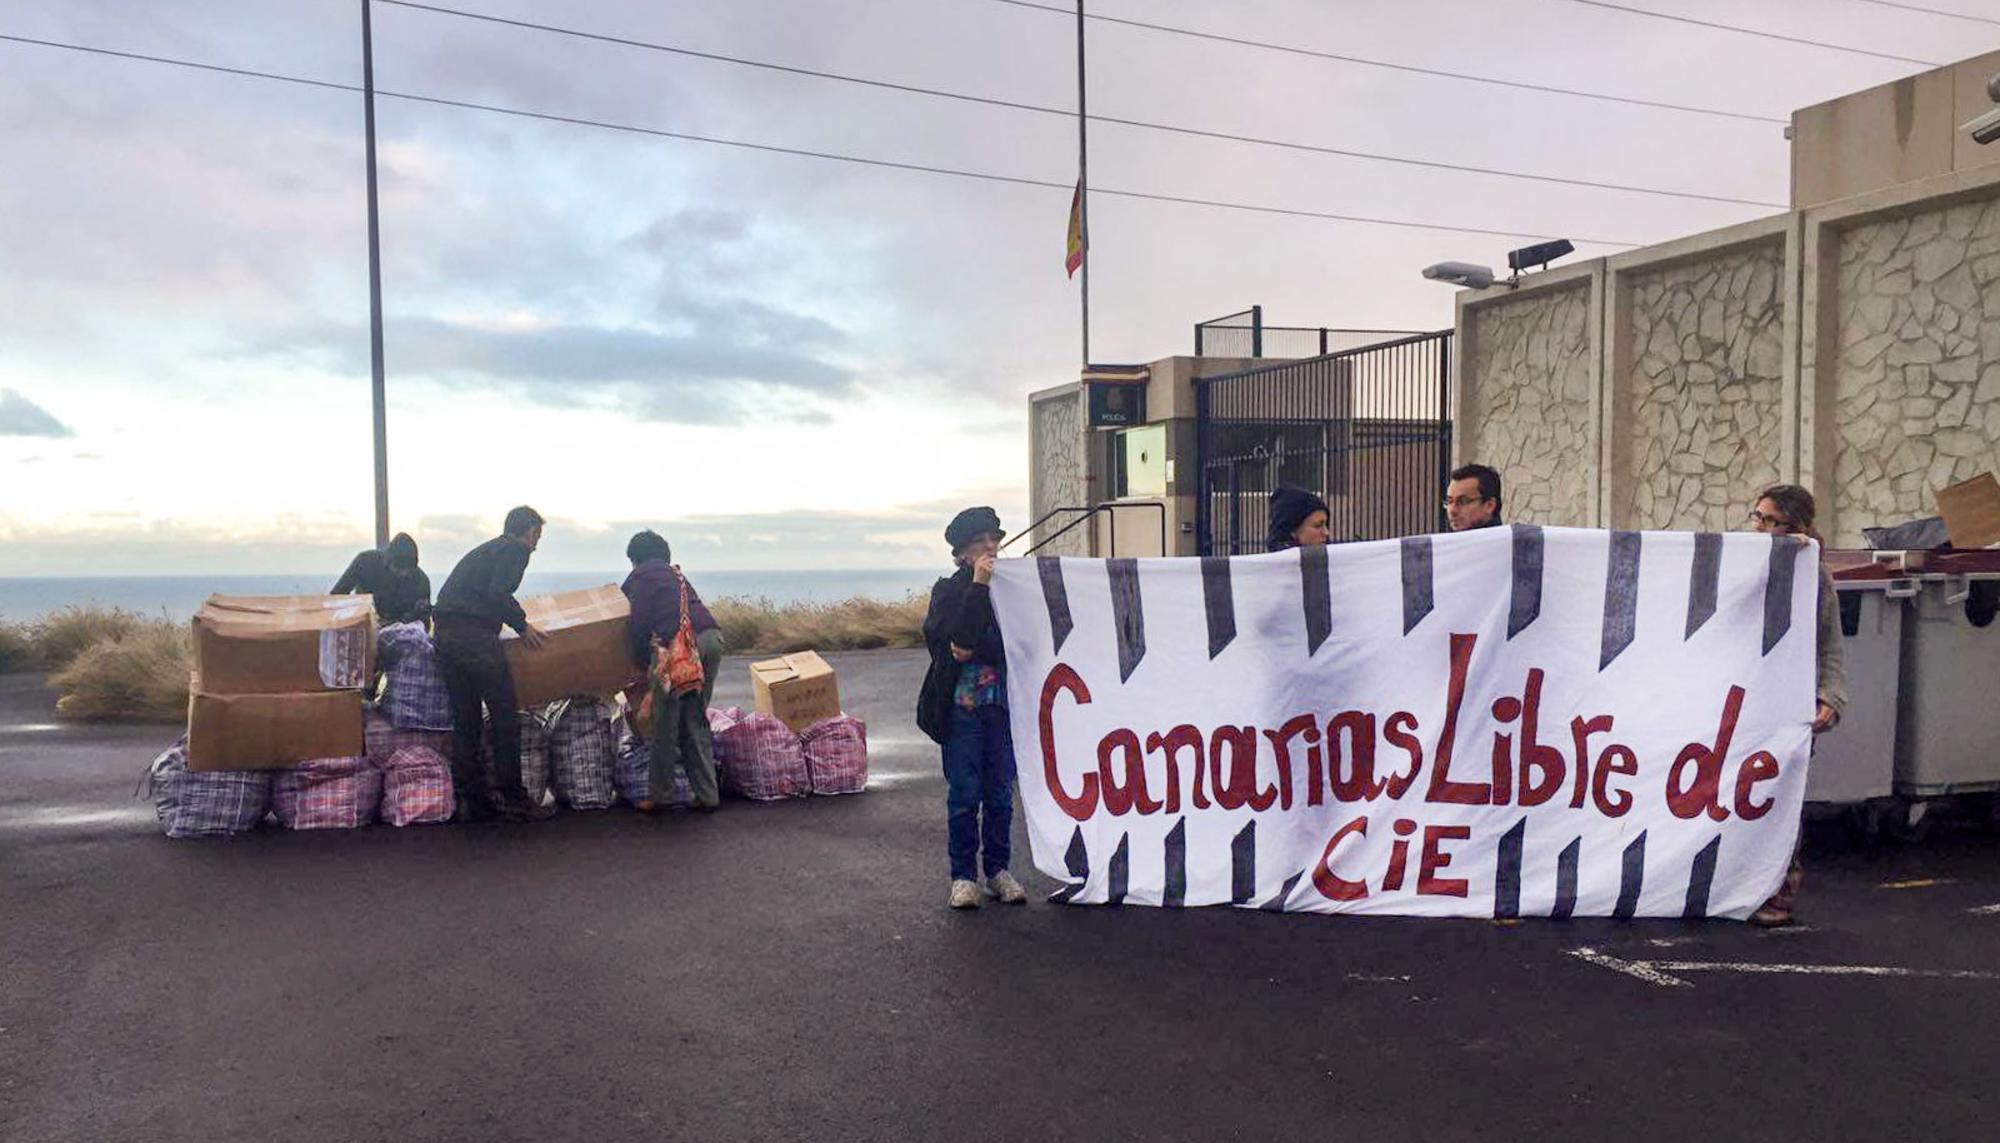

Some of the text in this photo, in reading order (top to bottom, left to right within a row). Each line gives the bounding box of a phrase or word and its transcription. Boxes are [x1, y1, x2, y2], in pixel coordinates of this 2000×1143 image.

[1039, 632, 1779, 821] Canarias Libre de
